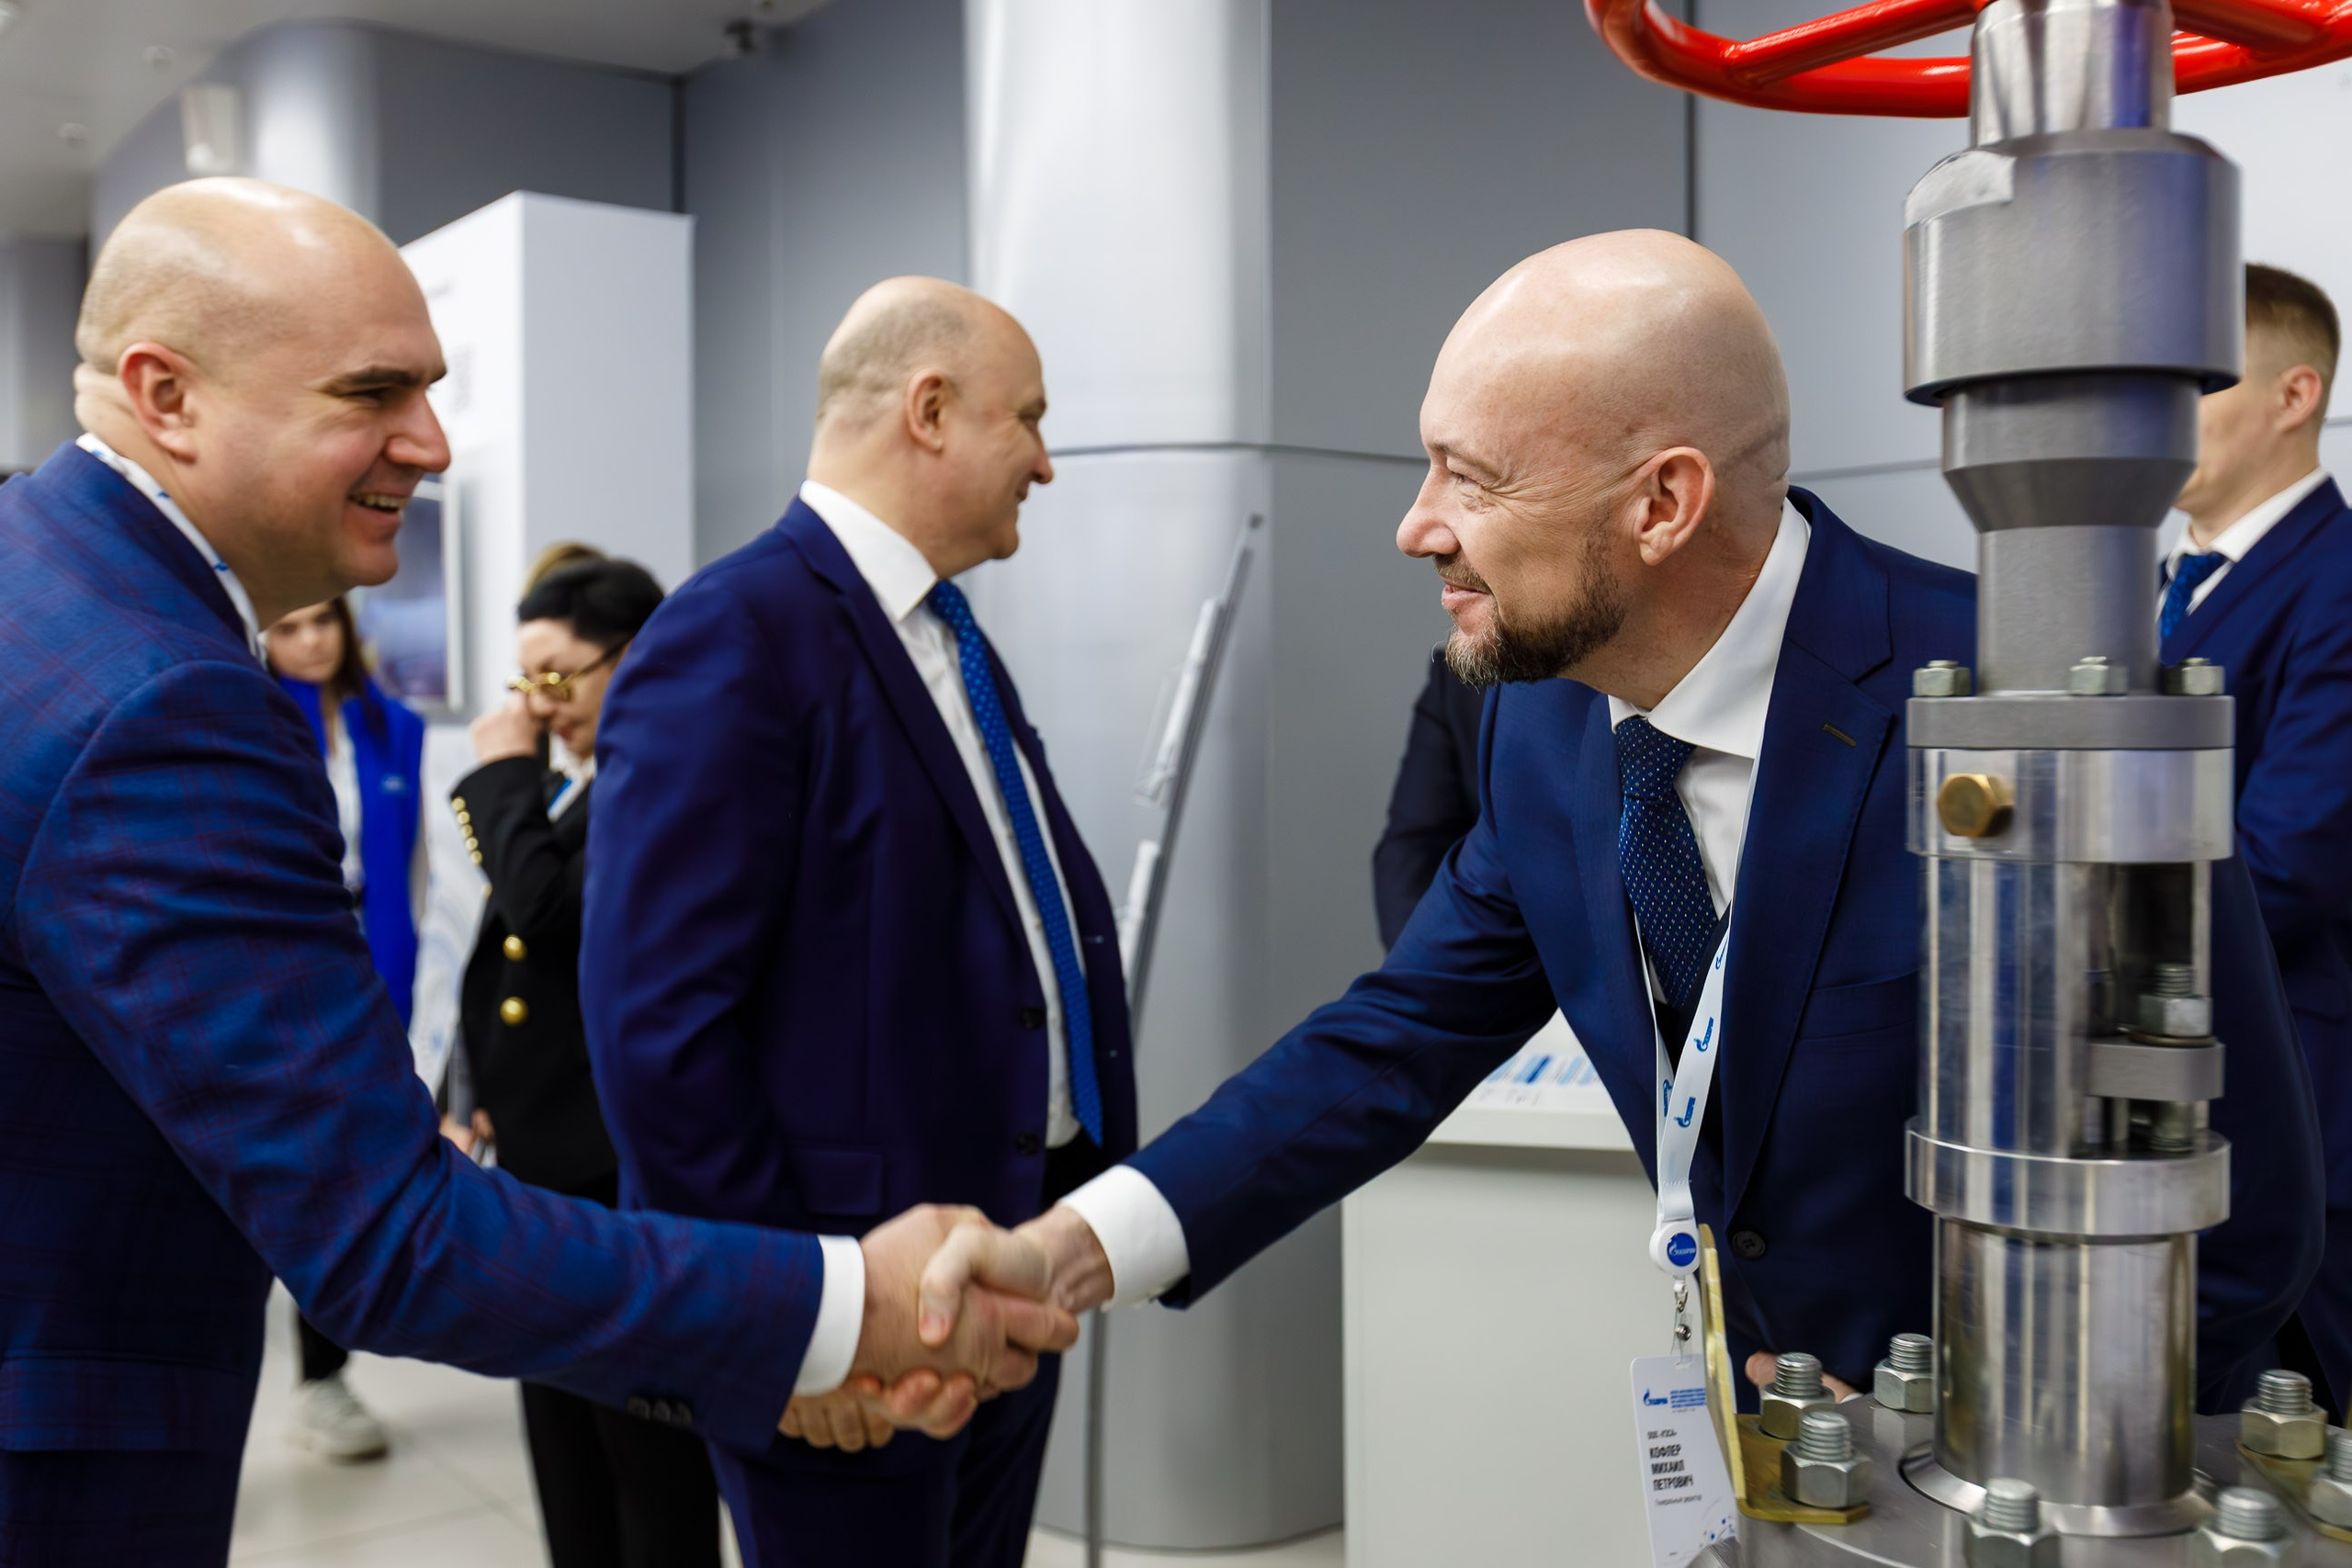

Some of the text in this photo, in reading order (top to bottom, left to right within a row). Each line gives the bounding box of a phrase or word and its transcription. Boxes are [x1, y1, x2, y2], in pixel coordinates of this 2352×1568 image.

[1649, 1443, 1681, 1459] КОФЛЕР
[1651, 1459, 1685, 1475] МИХАИЛ
[1653, 1474, 1694, 1491] ПЕТРОВИЧ
